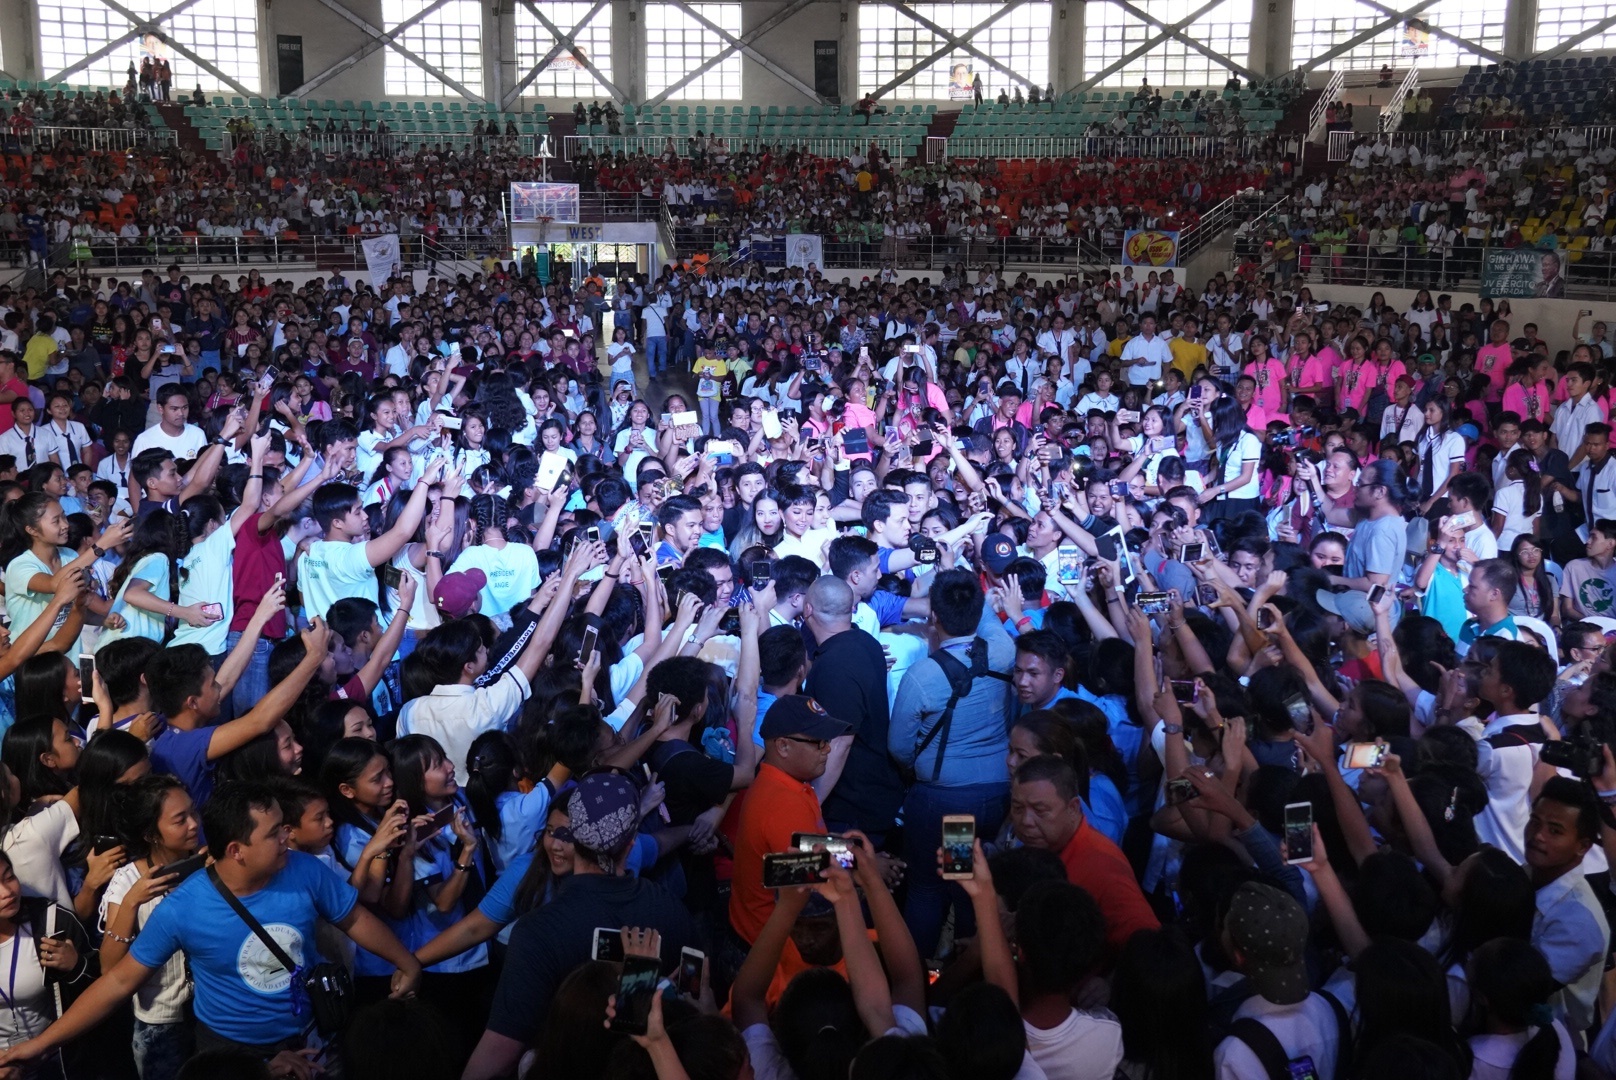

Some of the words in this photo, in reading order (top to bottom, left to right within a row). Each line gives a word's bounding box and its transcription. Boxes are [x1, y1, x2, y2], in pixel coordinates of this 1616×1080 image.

[569, 227, 600, 239] WEST
[1489, 254, 1536, 263] GINHAWA
[1506, 263, 1529, 271] BAYAN
[1496, 280, 1536, 289] EJERCITO
[1490, 287, 1524, 295] ESTRADA
[490, 569, 515, 578] PRESIDENT
